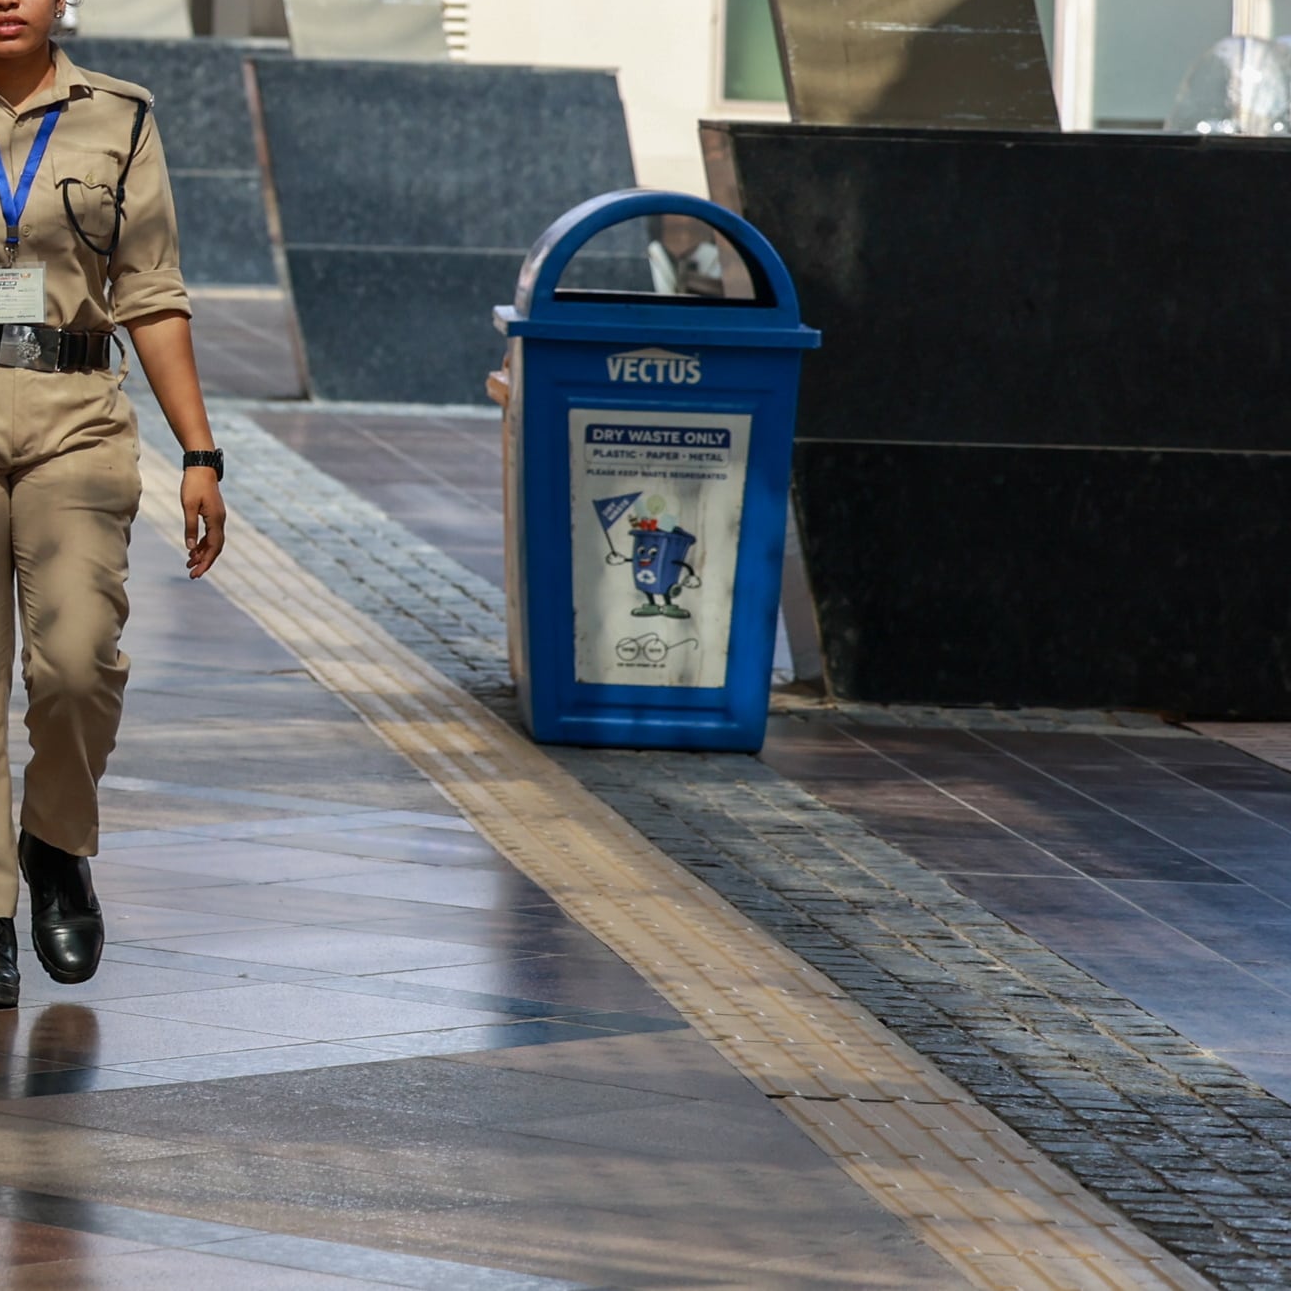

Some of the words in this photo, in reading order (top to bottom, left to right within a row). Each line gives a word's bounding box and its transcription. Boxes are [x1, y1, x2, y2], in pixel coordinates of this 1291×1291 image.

[606, 358, 702, 384] VECTUS
[592, 428, 624, 441] DRY
[628, 430, 681, 444] WASTE
[684, 432, 726, 445] ONLY
[593, 448, 636, 459] PLASTIC
[646, 451, 679, 460] PAPER
[688, 453, 723, 462] METAL
[587, 469, 615, 477] PLEASE
